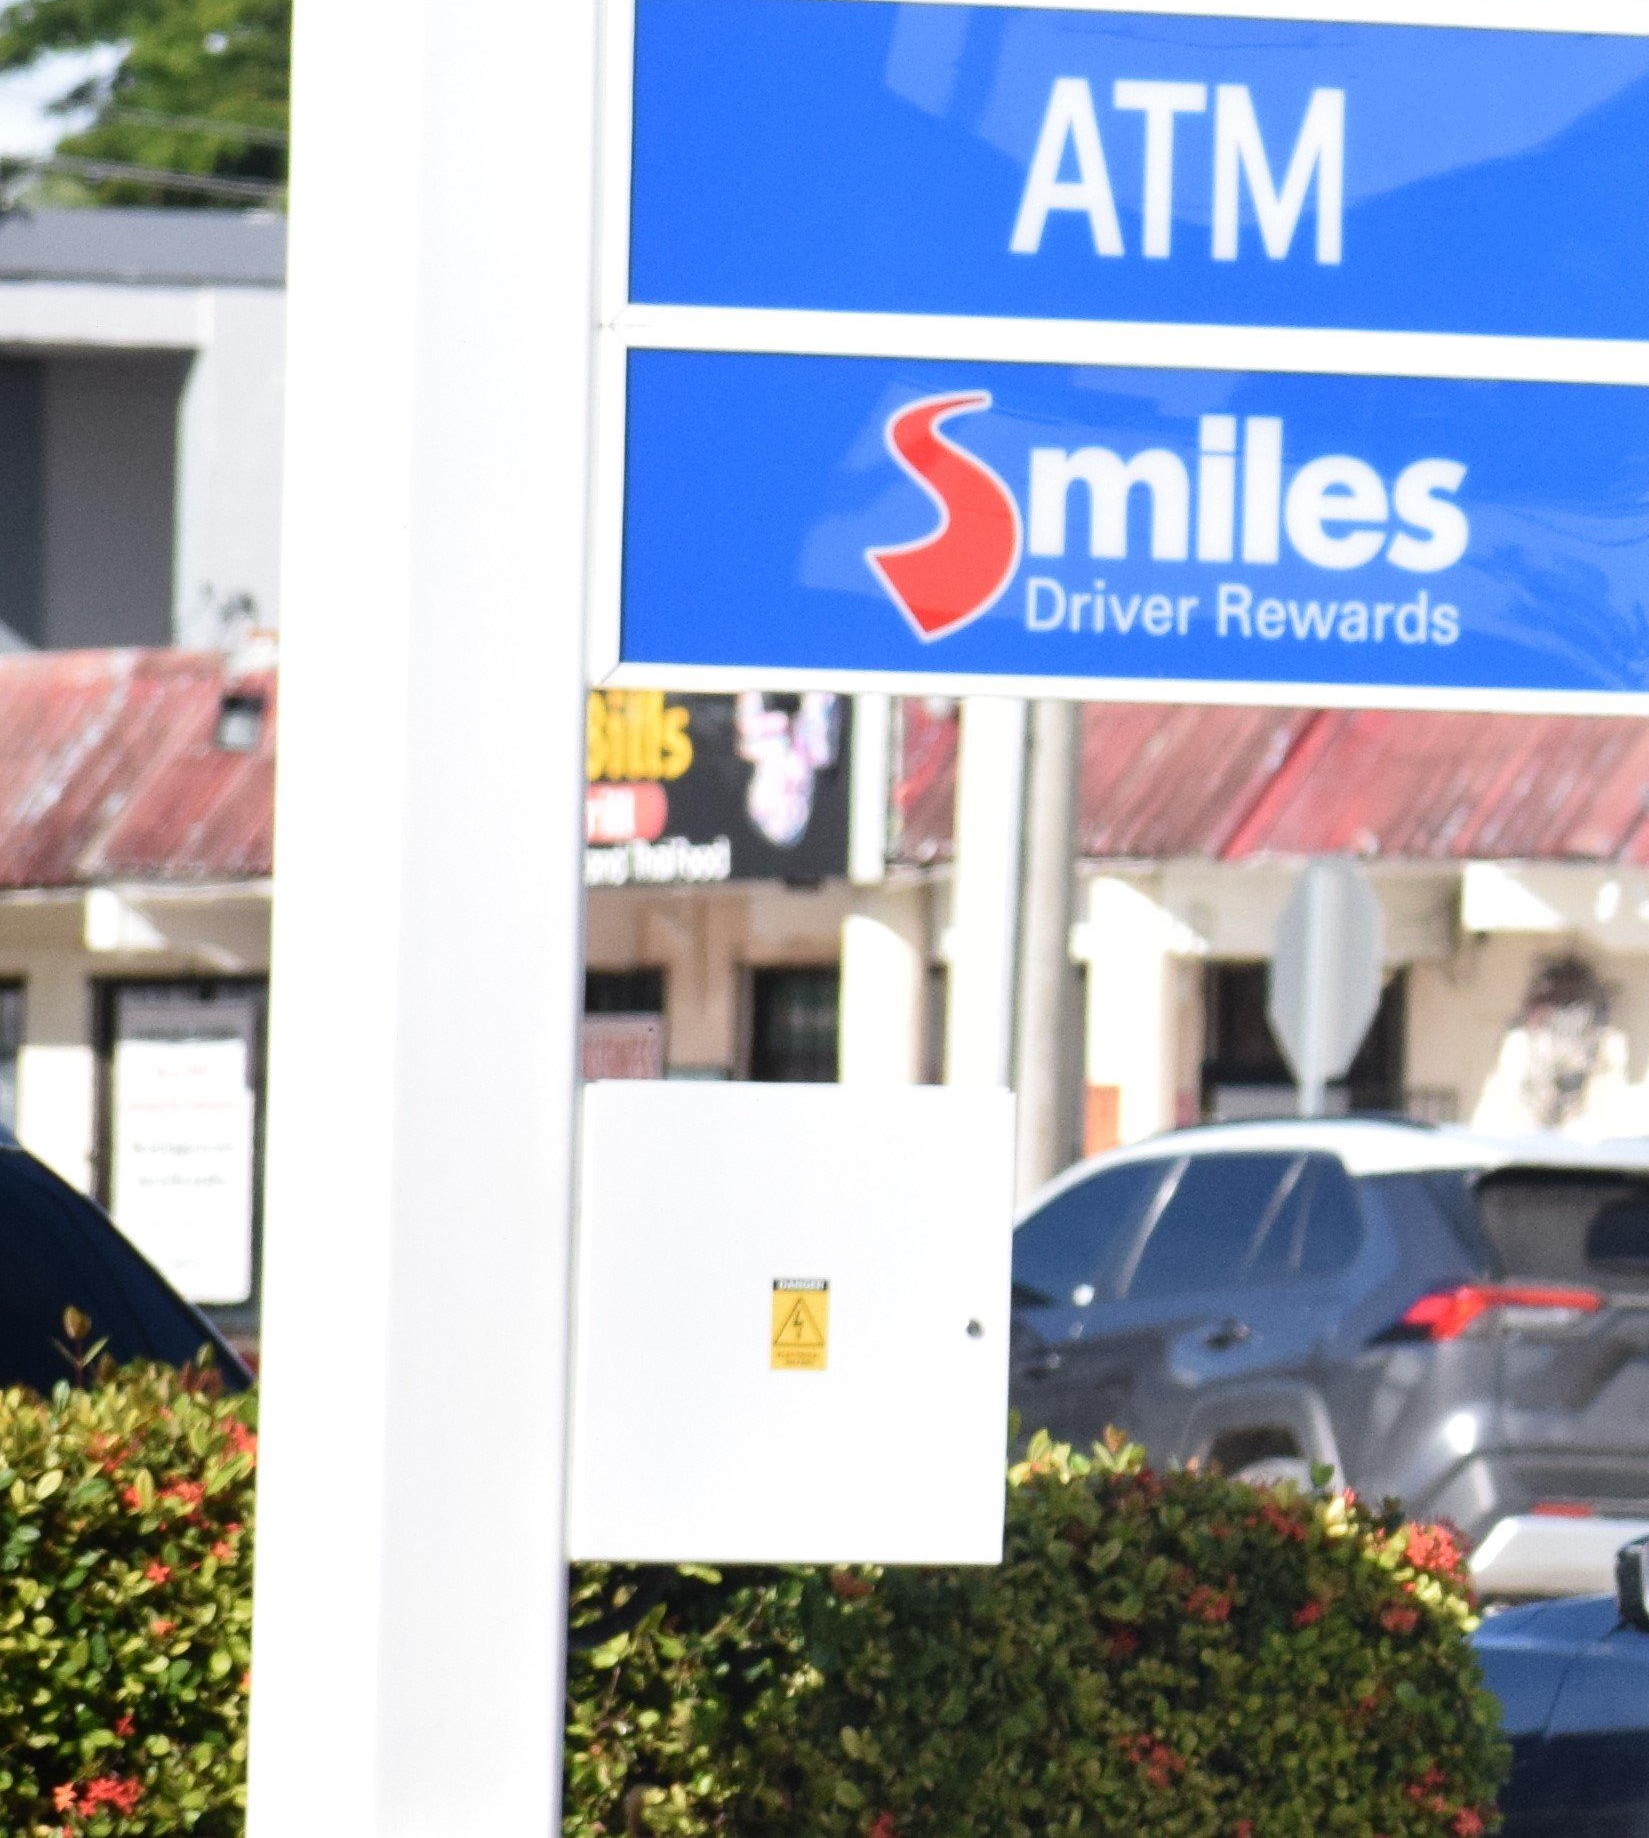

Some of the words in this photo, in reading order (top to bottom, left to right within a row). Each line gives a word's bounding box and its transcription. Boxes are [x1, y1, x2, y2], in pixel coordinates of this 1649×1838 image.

[1008, 76, 1345, 266] ATM
[1023, 577, 1199, 637] Driver
[1216, 584, 1461, 648] Rewards
